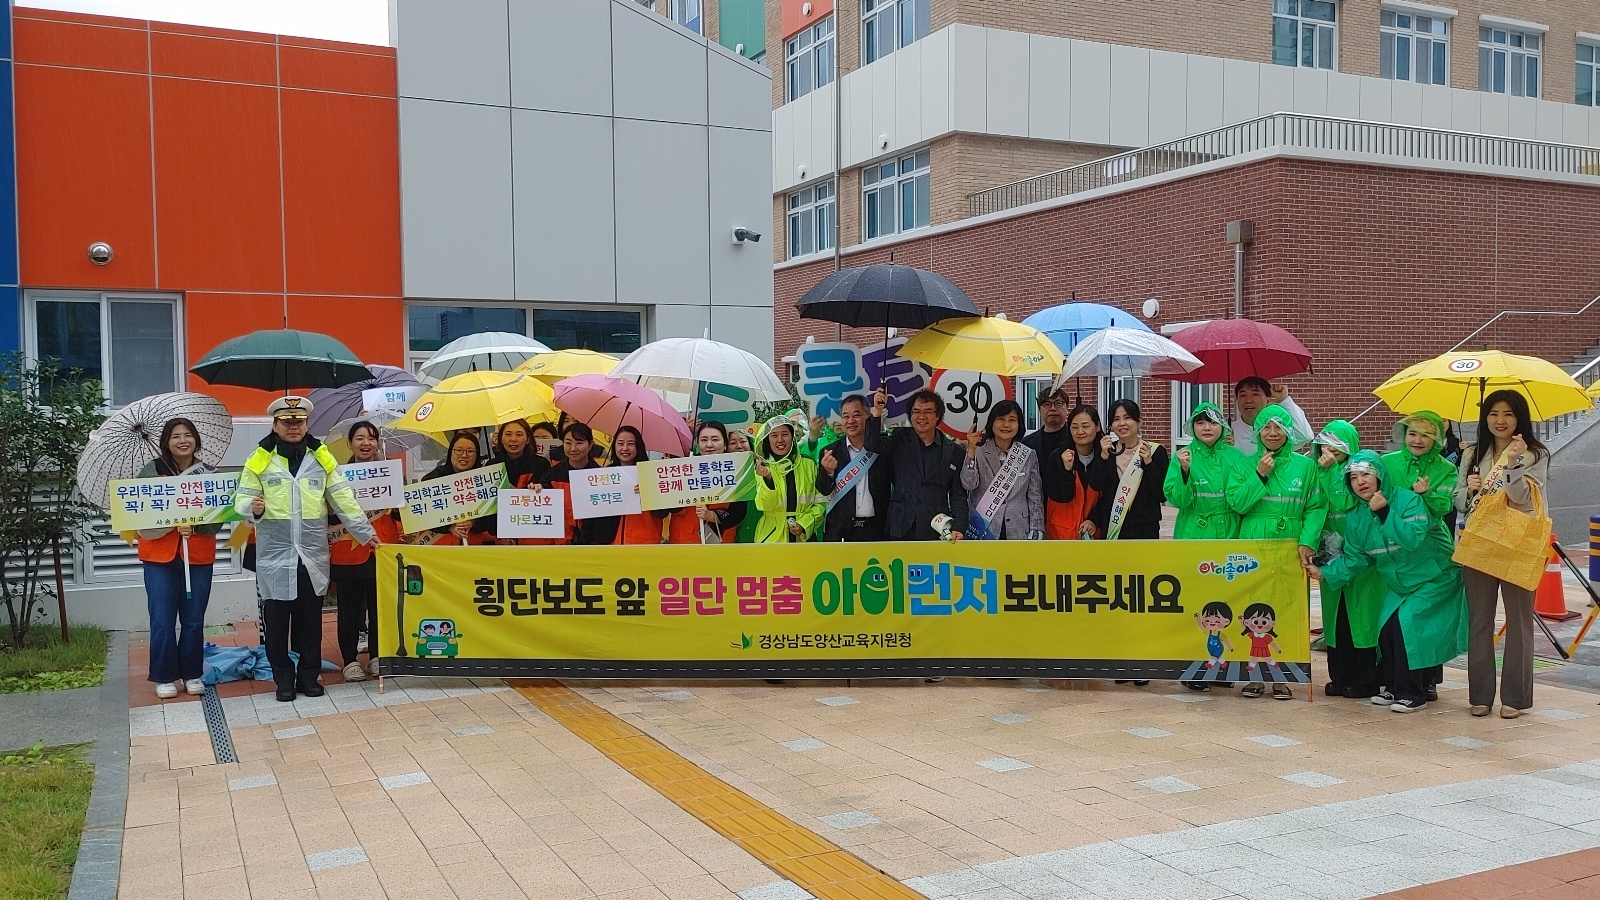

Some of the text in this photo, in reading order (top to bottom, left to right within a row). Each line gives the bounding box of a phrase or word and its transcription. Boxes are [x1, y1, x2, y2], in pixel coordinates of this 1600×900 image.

[1456, 361, 1475, 369] 30
[385, 391, 406, 403] 함께
[946, 381, 993, 414] 30
[344, 466, 391, 482] 횡단보도
[587, 472, 622, 487] 안전한
[656, 460, 736, 480] 안전한 통학로
[117, 479, 238, 499] 우리학교는 안전합니다
[404, 470, 503, 503] 우리학교는 안전합니다
[658, 474, 737, 494] 함께 만들어요
[125, 494, 233, 513] 꼭! 꼭! 약속해요
[411, 486, 499, 515] 꼭! 꼭! 약속해요
[509, 494, 553, 507] 교통신호
[589, 492, 623, 506] 통학로
[1112, 485, 1132, 524] 약속해요
[509, 514, 554, 526] 바로보고
[1198, 559, 1259, 581] 아이좋아
[473, 576, 606, 616] 횡단보도
[614, 576, 650, 616] 앞
[657, 576, 727, 616] 일단
[735, 575, 804, 616] 멈춤
[1003, 573, 1185, 615] 보내주세요
[758, 632, 913, 650] 경상남도양산교육지원청
